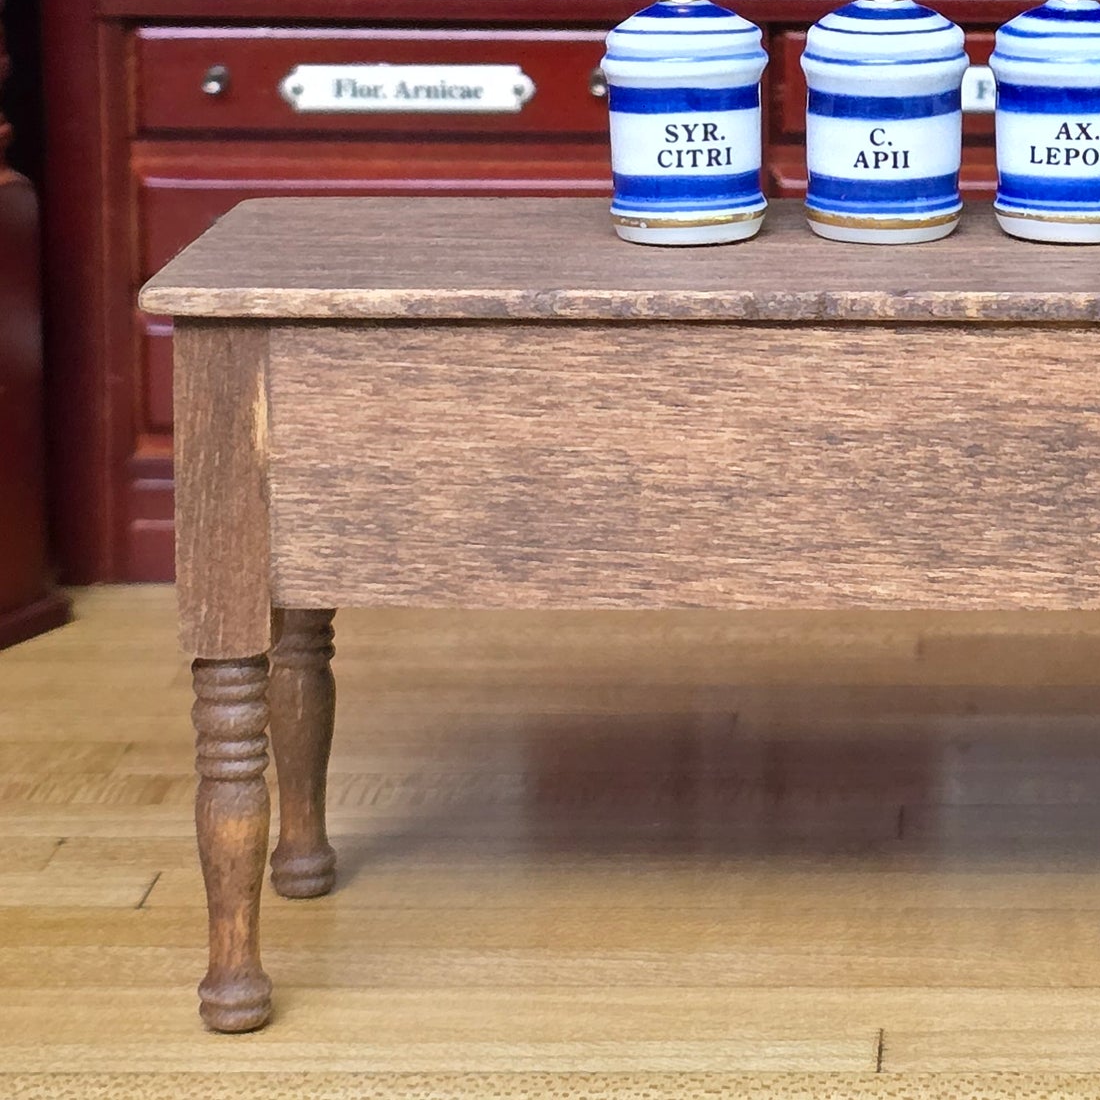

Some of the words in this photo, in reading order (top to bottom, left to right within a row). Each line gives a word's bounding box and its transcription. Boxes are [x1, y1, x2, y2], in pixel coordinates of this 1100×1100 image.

[333, 78, 387, 100] Flor.
[395, 79, 485, 100] Arnicae
[664, 122, 727, 144] SYR.
[868, 127, 894, 147] C.
[1054, 121, 1100, 142] AX.
[656, 147, 733, 169] CITRI
[852, 150, 911, 170] APII
